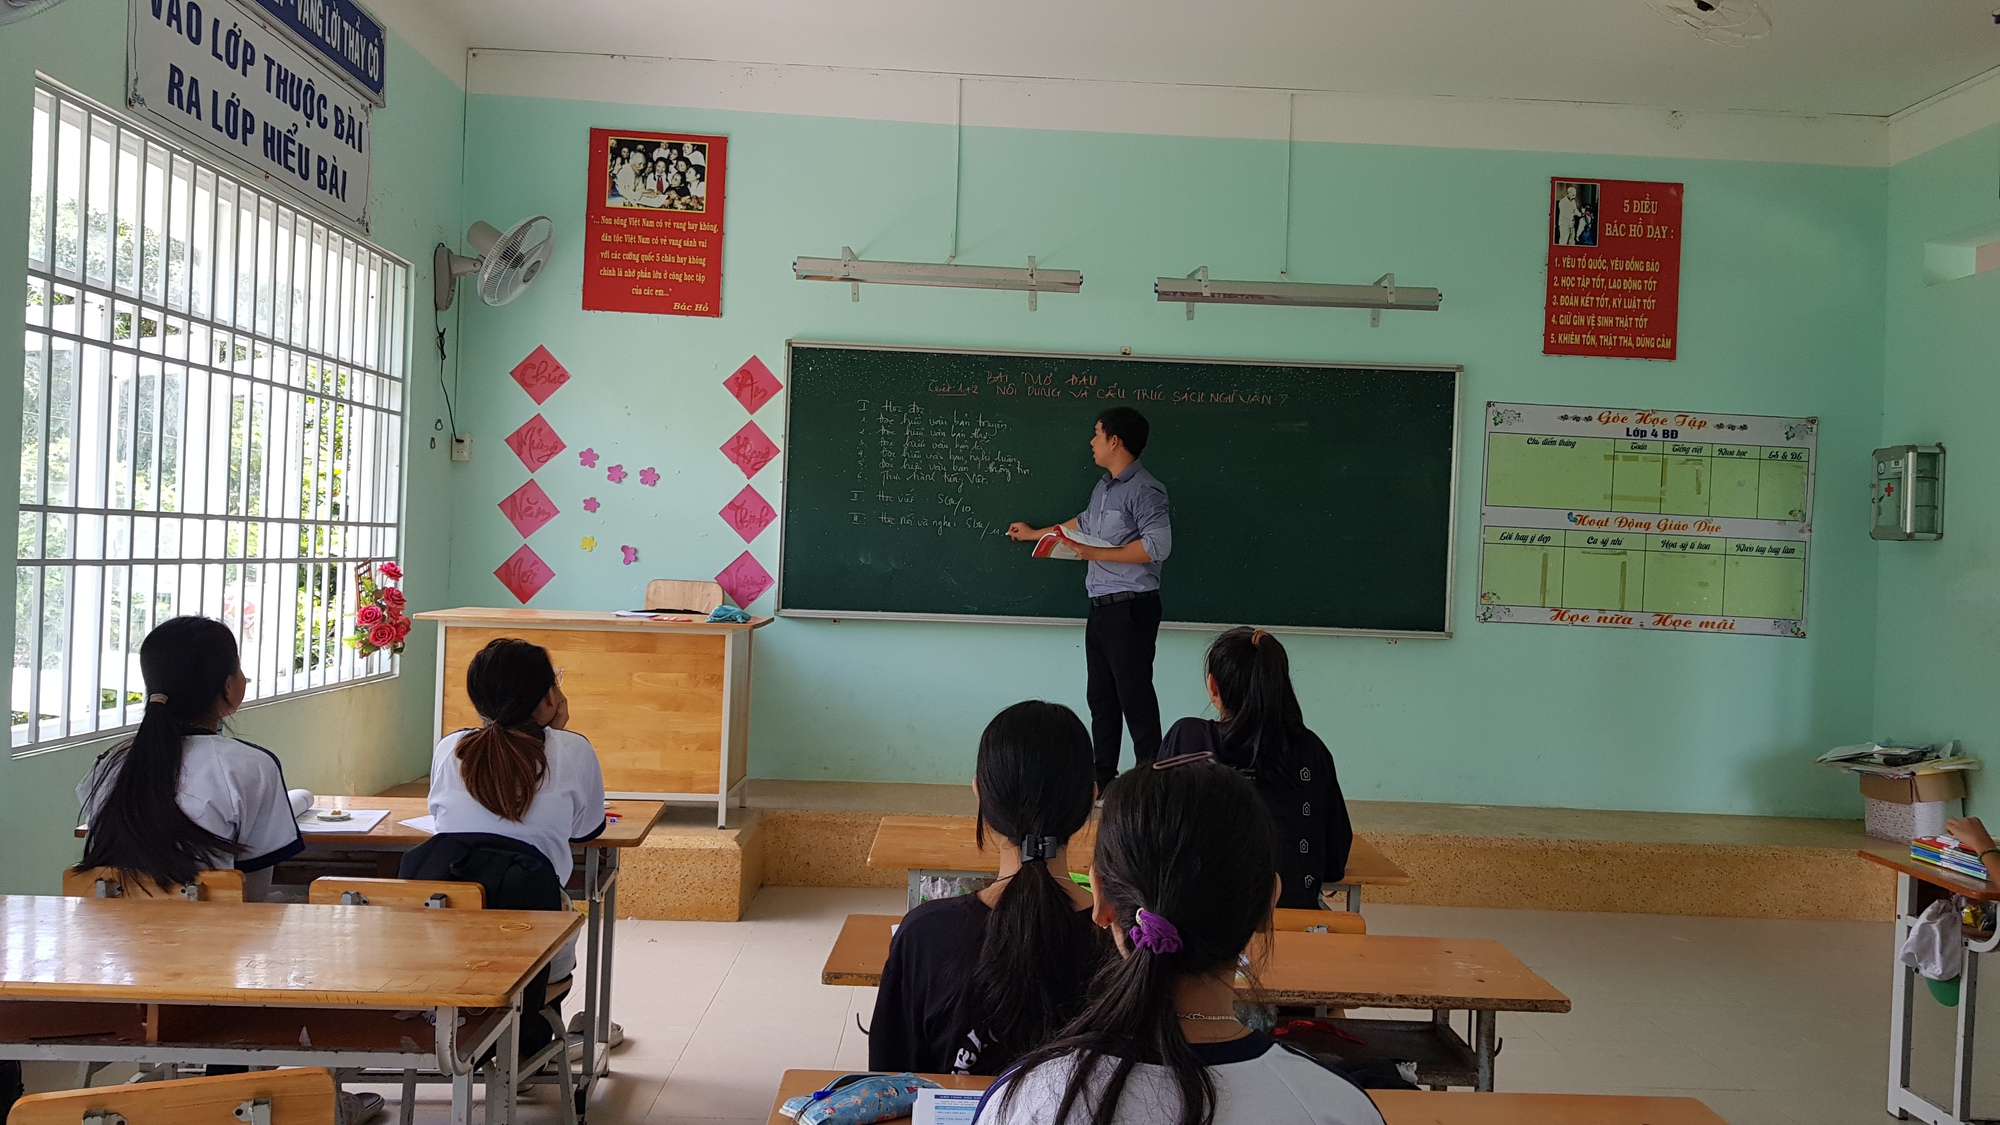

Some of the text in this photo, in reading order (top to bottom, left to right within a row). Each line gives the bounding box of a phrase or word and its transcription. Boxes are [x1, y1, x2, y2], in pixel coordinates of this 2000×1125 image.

[325, 1, 341, 52] LỜI
[343, 16, 366, 71] THẦY
[368, 38, 379, 82] CÔ
[212, 18, 256, 78] LỚP
[264, 54, 328, 129] THUỘC
[334, 104, 363, 154] BÀI
[168, 63, 347, 202] RA LỚP HIỂU BÀI
[1623, 193, 1658, 214] 5 ĐIỀU
[601, 216, 612, 224] Non
[629, 217, 640, 228] Việt
[642, 218, 654, 228] Nam
[673, 220, 686, 231] vang
[688, 221, 698, 232] hay
[1605, 217, 1669, 242] BÁC HỒ DẠY
[624, 234, 636, 245] Việt
[638, 235, 650, 244] Nam
[669, 238, 682, 248] vang
[611, 250, 621, 259] các
[656, 253, 660, 261] 5
[677, 254, 687, 265] hay
[1554, 257, 1560, 268] 1.
[1562, 255, 1576, 268] YÊU
[1577, 253, 1587, 268] TỔ
[1610, 257, 1624, 271] YÊU
[1645, 258, 1660, 272] BÀO
[644, 286, 654, 295] các
[1553, 276, 1559, 287] 2.
[1561, 276, 1575, 290] HỌC
[1577, 275, 1591, 290] TẬP
[1608, 278, 1621, 290] LAO
[1623, 277, 1642, 293] ĐỘNG
[1644, 276, 1657, 291] TỐT
[673, 302, 692, 311] Bác
[1552, 295, 1558, 306] 3.
[1560, 293, 1579, 307] ĐOÀN
[1580, 292, 1594, 307] KẾT
[1623, 296, 1641, 312] LUẬT
[1642, 295, 1656, 310] TỐT
[1551, 312, 1648, 331] 4. GIỮ GÌN VỆ SINH THẬT TỐT
[1550, 333, 1556, 343] 5.
[1558, 331, 1580, 345] KHIÊM
[1599, 333, 1618, 349] THẬT
[1636, 334, 1655, 348] DŨNG
[1656, 334, 1672, 349] CẢM
[519, 360, 568, 388] Chúc
[1028, 386, 1061, 398] DUNG
[1597, 410, 1707, 430] Góc Học Tập
[1626, 427, 1678, 439] Lớp 4 BĐ
[1558, 438, 1577, 448] tháng
[1630, 442, 1648, 450] Toán
[1575, 514, 1722, 534] Hoạt Động Giáo Dục
[1514, 532, 1529, 543] hay
[1538, 534, 1551, 544] đẹp
[1586, 536, 1598, 546] Ca
[1698, 542, 1711, 550] hon
[1549, 608, 1736, 630] Học nữa Học mãi
